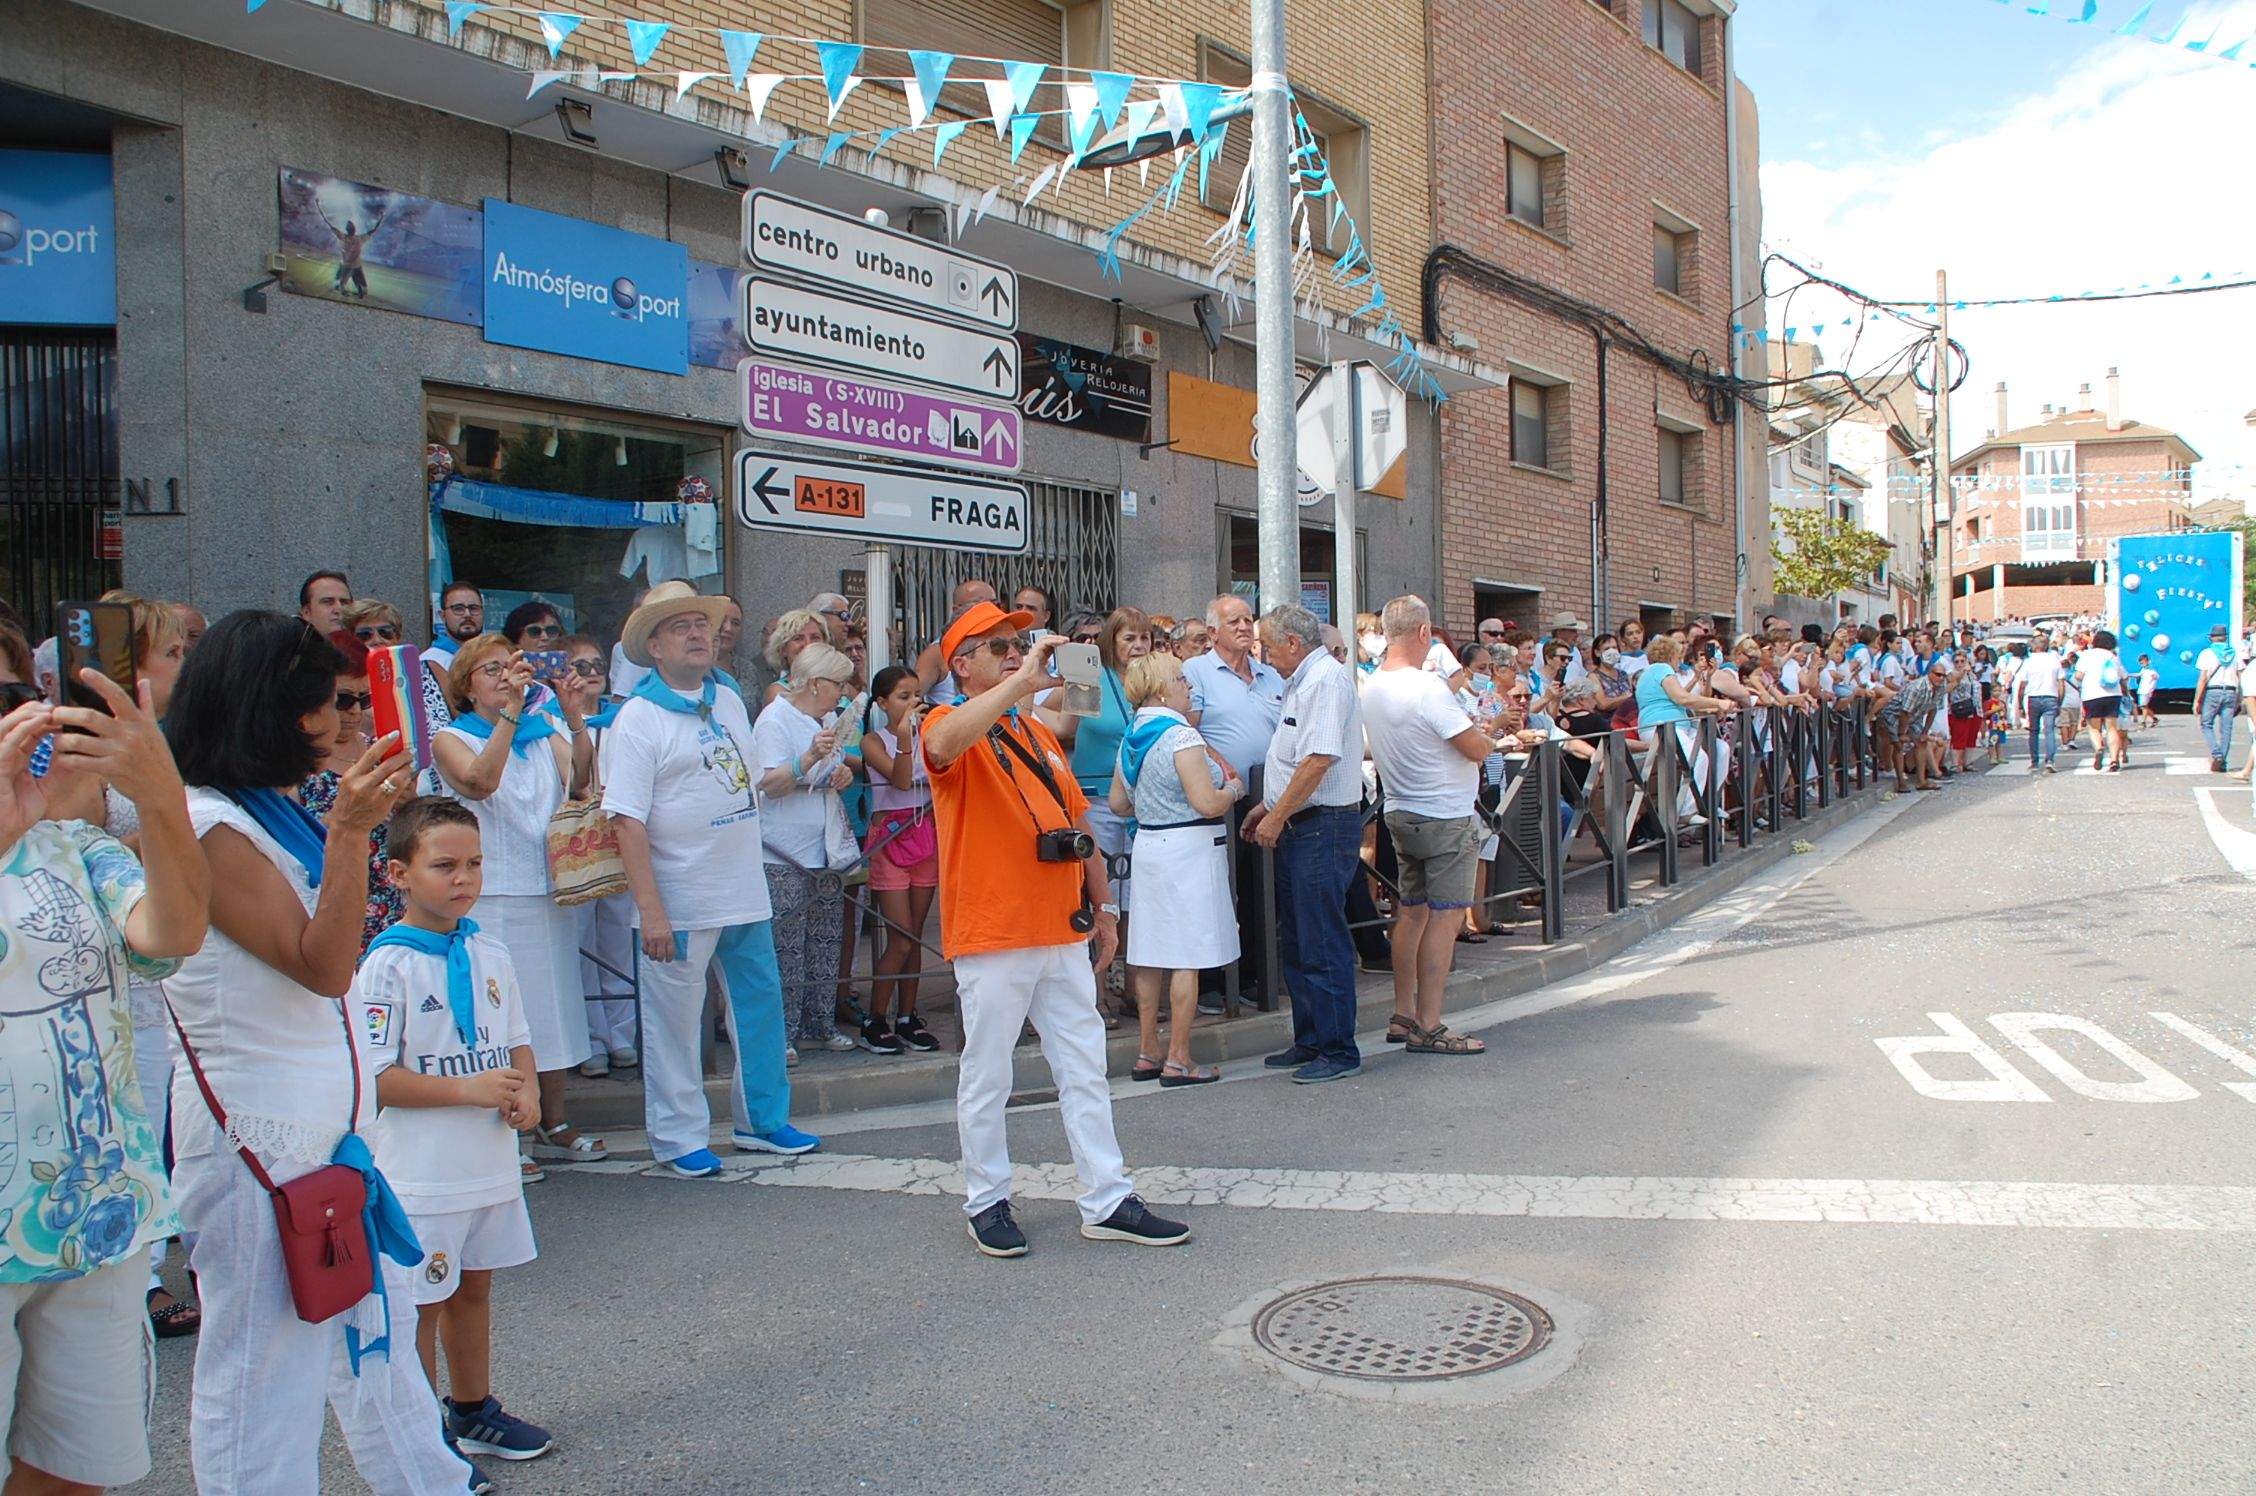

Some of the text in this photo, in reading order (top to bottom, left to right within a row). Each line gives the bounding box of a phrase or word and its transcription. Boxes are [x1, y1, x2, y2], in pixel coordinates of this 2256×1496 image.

[758, 222, 933, 288] centro urbano
[493, 251, 608, 309] Atmósfera
[755, 305, 925, 360] ayuntamiento
[754, 366, 814, 396] iglesia
[1050, 350, 1113, 377] JOYERIA
[1087, 373, 1147, 398] RELOJERIA
[754, 394, 922, 445] El Salvador
[799, 483, 1020, 531] A-131 FRAGA
[417, 1045, 511, 1077] Emirate
